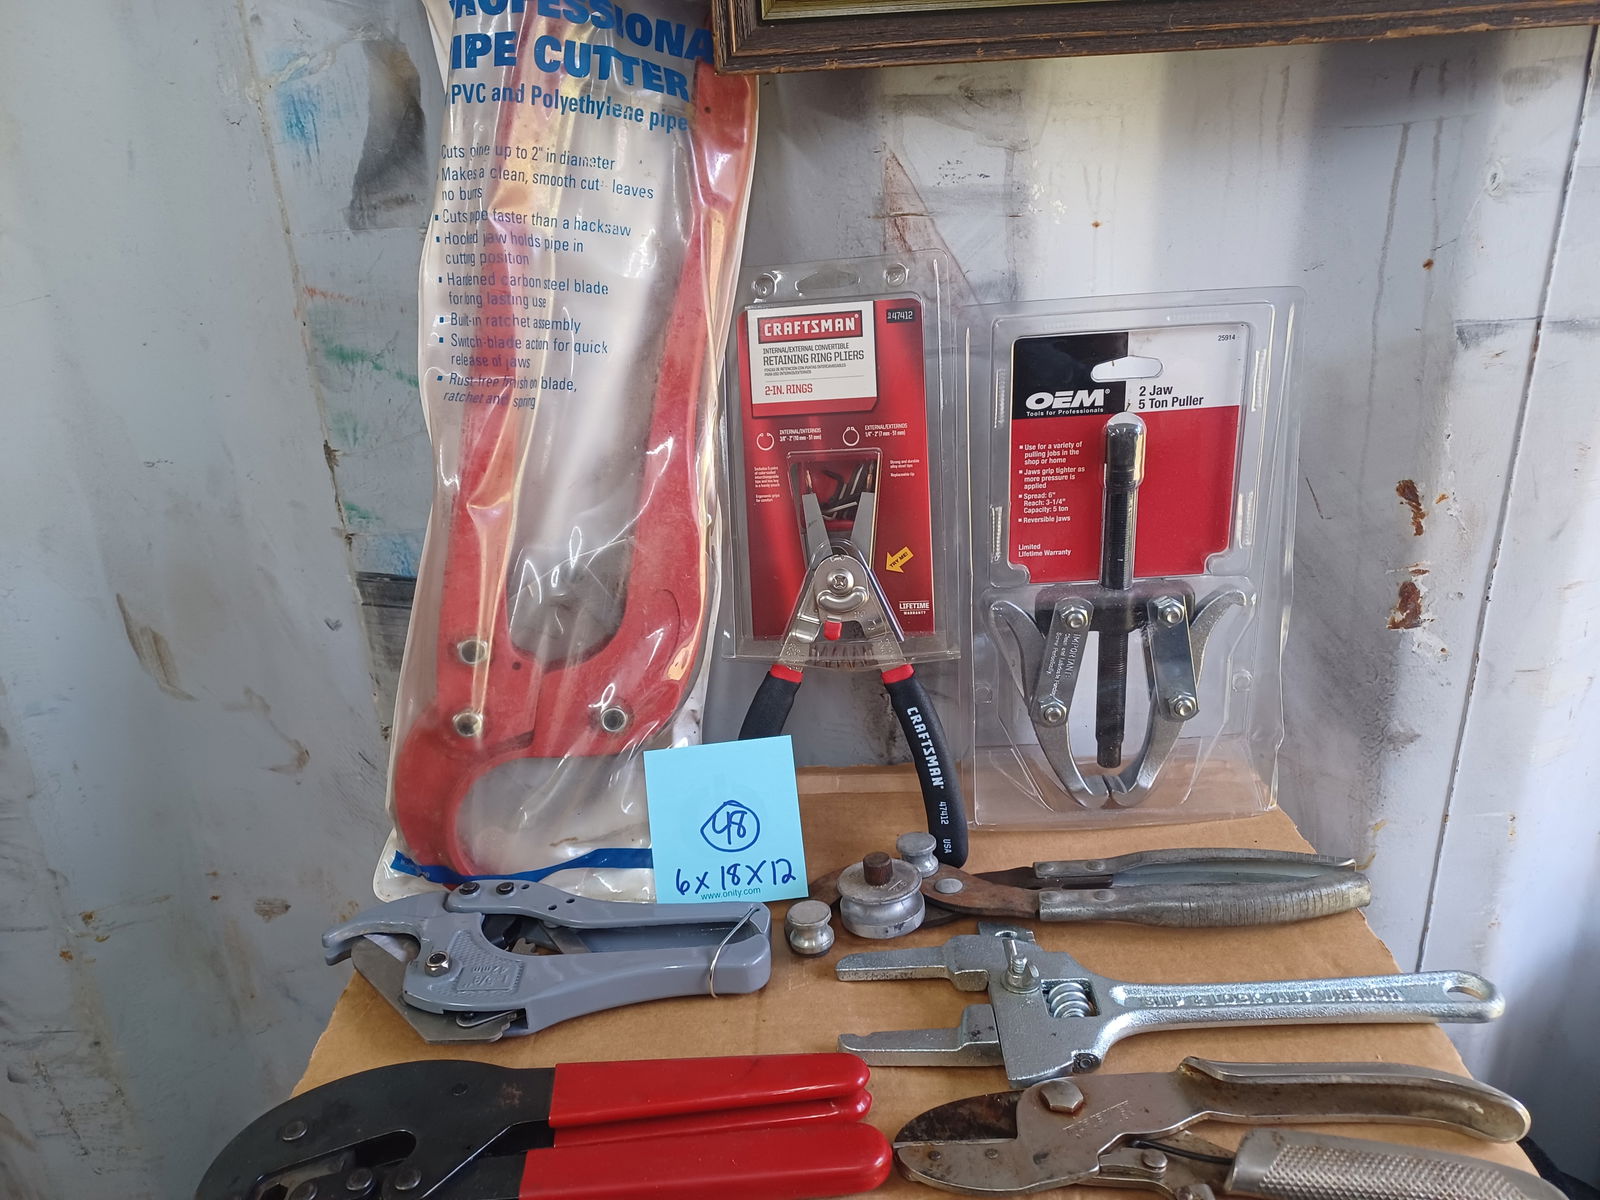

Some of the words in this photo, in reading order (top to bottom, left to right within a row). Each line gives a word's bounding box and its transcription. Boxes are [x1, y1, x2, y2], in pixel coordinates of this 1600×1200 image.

[534, 34, 690, 102] CUTTER
[451, 83, 486, 105] PVC
[491, 83, 524, 104] and
[531, 85, 644, 124] Polyethylene
[650, 109, 689, 134] pipe
[441, 144, 465, 160] Cuts
[495, 145, 511, 160] up
[516, 146, 527, 160] to
[532, 146, 543, 161] 2"
[546, 148, 557, 163] in
[560, 150, 615, 171] diameter
[441, 166, 477, 181] Makes
[480, 168, 485, 179] a
[489, 165, 528, 185] clean,
[532, 172, 576, 189] smooth
[612, 179, 654, 199] leaves
[442, 189, 455, 201] no
[443, 211, 468, 224] Cuts
[493, 208, 528, 225] faster
[531, 212, 558, 229] than
[562, 218, 569, 230] a
[574, 216, 632, 237] hacksaw
[482, 231, 507, 247] jaw
[511, 231, 541, 248] holds
[545, 236, 569, 253] pipe
[573, 238, 584, 253] in
[480, 250, 529, 267] position
[500, 274, 541, 289] carbon
[543, 278, 570, 292] steel
[574, 278, 609, 295] blade
[448, 291, 463, 305] for
[487, 292, 529, 310] lasting
[532, 296, 547, 309] use
[486, 313, 531, 328] ratchet
[533, 318, 582, 335] assembly
[764, 316, 856, 338] CRAFTSMAN
[1217, 334, 1236, 342] 25914
[553, 338, 570, 352] for
[574, 340, 608, 356] quick
[814, 342, 849, 353] CONVERTIBLE
[451, 353, 489, 367] release
[492, 354, 502, 367] of
[505, 354, 531, 371] jaws
[763, 352, 809, 367] RETAINING
[811, 351, 832, 363] RING
[834, 350, 865, 362] PLIERS
[541, 375, 578, 393] blade,
[764, 384, 785, 396] 2-IN.
[786, 383, 813, 395] RINGS
[1139, 386, 1147, 397] 2
[1149, 385, 1173, 396] Jaw
[443, 391, 484, 405] ratchet
[1025, 388, 1106, 411] OEM
[1138, 398, 1146, 410] 5
[1149, 398, 1168, 409] Ton
[1171, 395, 1204, 407] Puller
[1058, 407, 1104, 416] Professionals
[1024, 443, 1036, 451] Use
[1053, 441, 1075, 450] variety
[1024, 450, 1046, 459] pulling
[1047, 450, 1061, 458] jobs
[1024, 458, 1040, 466] shop
[1024, 468, 1041, 476] Jaws
[1042, 468, 1054, 476] grip
[1055, 466, 1076, 475] tighter
[1023, 481, 1047, 491] applied
[1041, 475, 1068, 483] pressure
[1023, 492, 1047, 501] Spread:
[1023, 506, 1052, 514] Capacity:
[1056, 515, 1071, 523] jaws
[1018, 543, 1041, 551] Limited
[1018, 550, 1043, 558] Lifetime
[1044, 548, 1072, 556] Warranty
[889, 558, 900, 568] TRY
[899, 601, 930, 610] LIFETIME
[906, 706, 945, 789] CRAFTSMAN
[939, 801, 950, 825] 47412
[711, 809, 748, 845] 48
[942, 838, 953, 854] USA
[700, 886, 761, 901] www.onity.com
